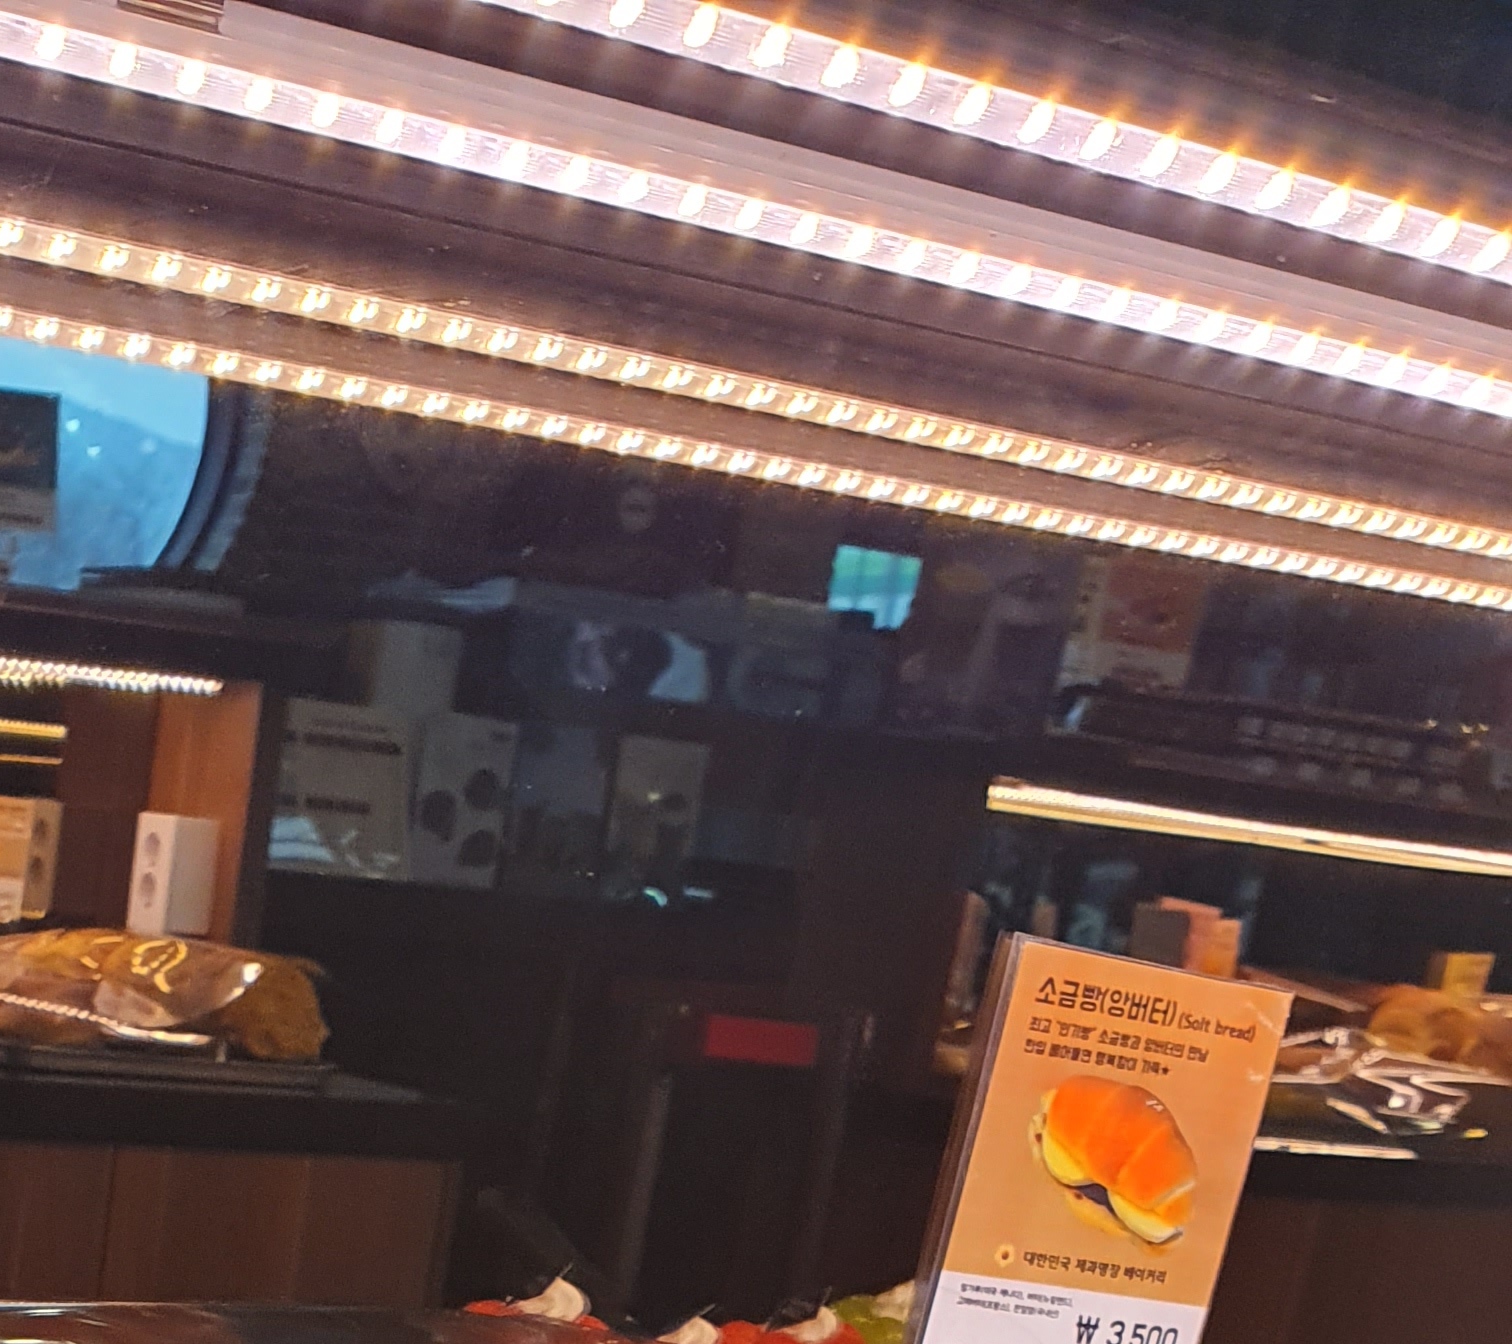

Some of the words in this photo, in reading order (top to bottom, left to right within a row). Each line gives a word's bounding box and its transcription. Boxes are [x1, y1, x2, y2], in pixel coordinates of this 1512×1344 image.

[1034, 976, 1178, 1027] 소금빵(앙버터)
[1214, 1018, 1257, 1044] bread)
[1023, 1251, 1072, 1271] 대한민국
[1075, 1258, 1121, 1279] 제과명장
[1123, 1266, 1168, 1284] 베이커리
